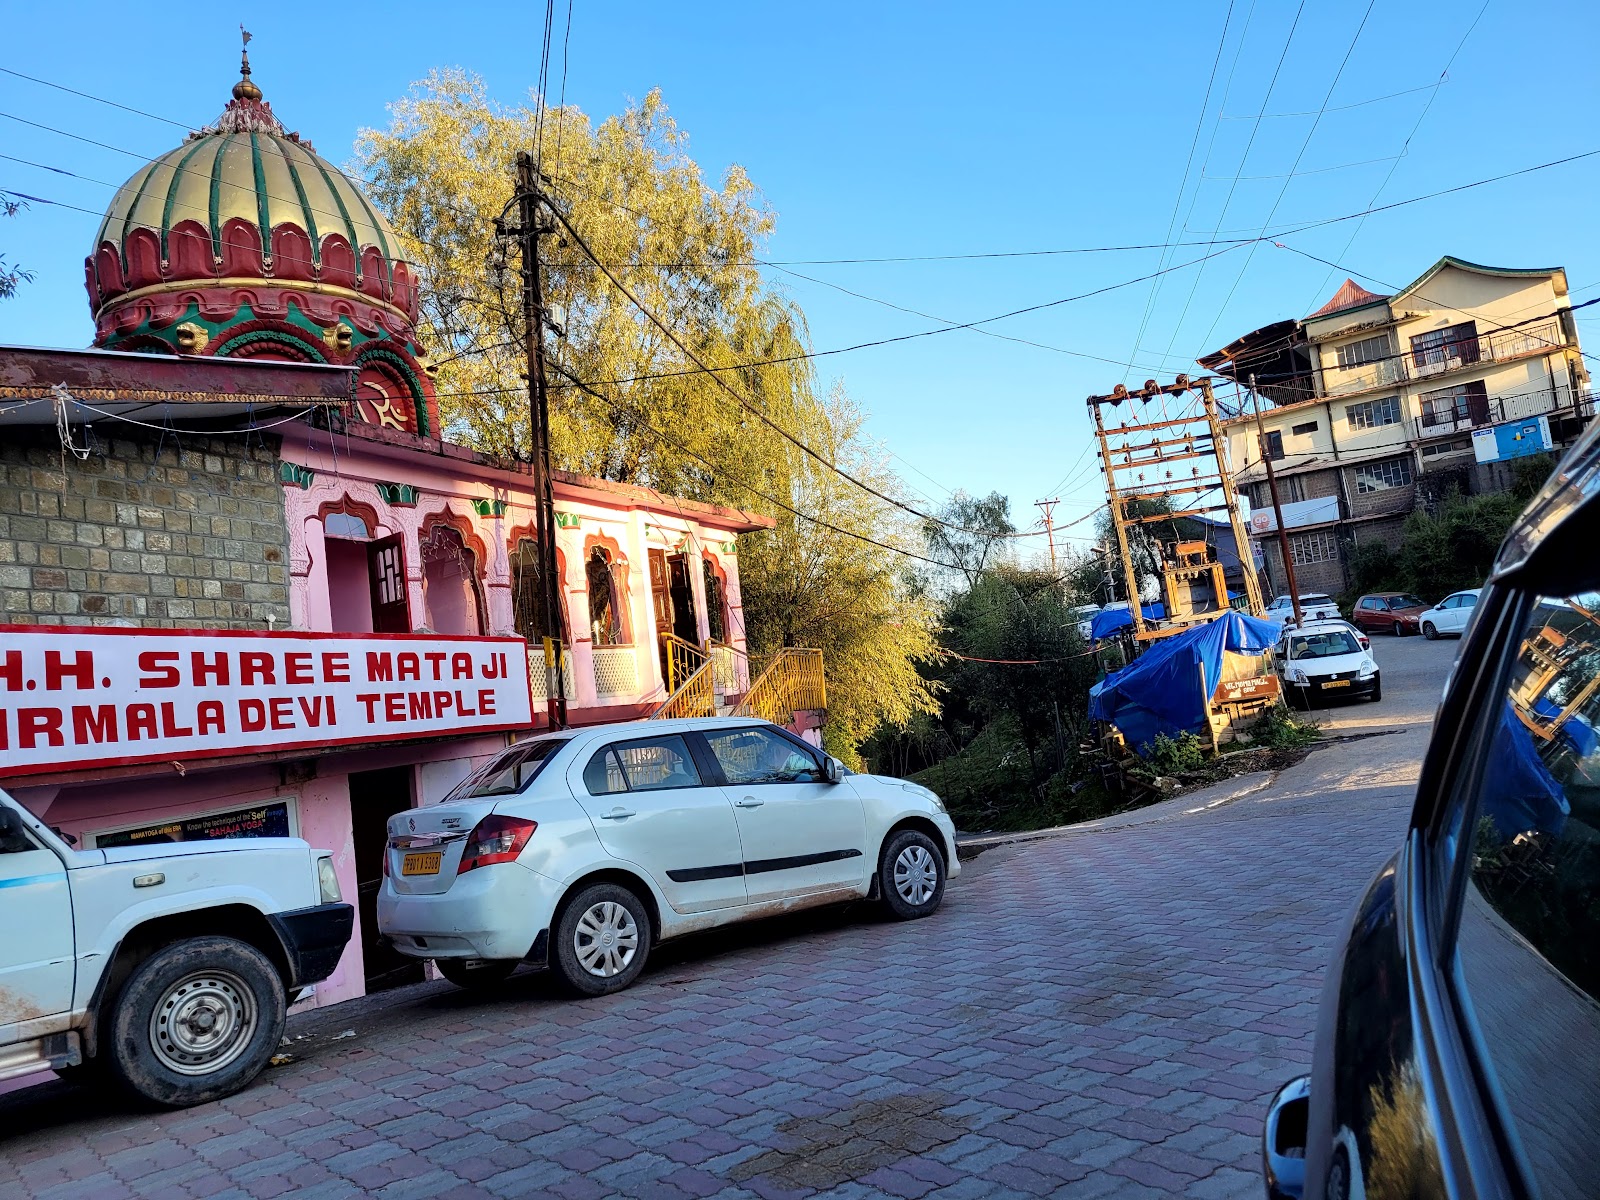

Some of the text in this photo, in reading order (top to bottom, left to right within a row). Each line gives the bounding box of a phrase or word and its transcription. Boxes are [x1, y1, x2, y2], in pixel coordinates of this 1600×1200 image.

[138, 651, 350, 689] SHREE
[238, 695, 337, 732] DEVI
[356, 689, 497, 723] TEMPLE
[187, 822, 202, 831] Know
[203, 820, 211, 828] the
[212, 816, 237, 827] technique
